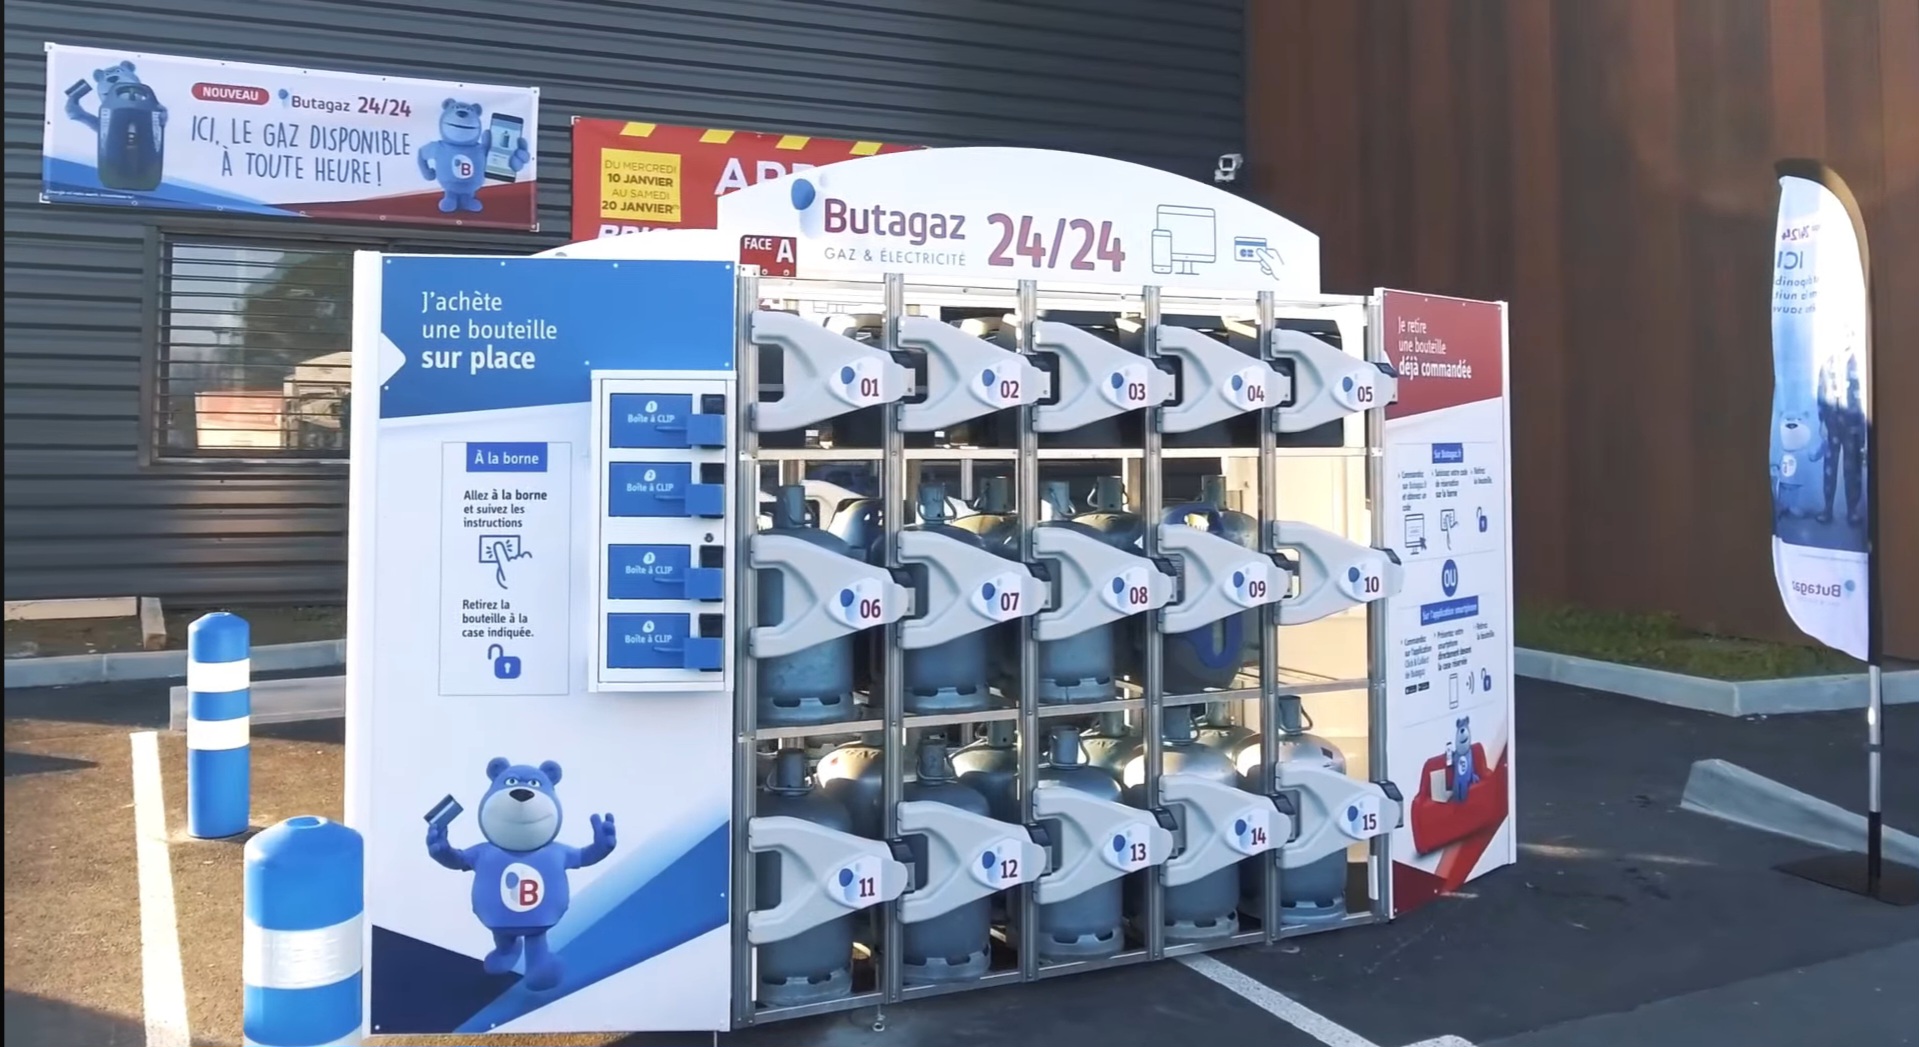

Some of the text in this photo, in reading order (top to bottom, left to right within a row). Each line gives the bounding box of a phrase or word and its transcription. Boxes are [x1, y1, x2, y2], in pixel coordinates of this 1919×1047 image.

[202, 86, 259, 101] NOUVEAU
[291, 95, 412, 117] Butagaz 24/24
[231, 118, 252, 145] LE
[263, 122, 299, 148] GAZ
[310, 125, 411, 156] DISPONIBLE
[221, 144, 233, 177] À
[245, 152, 304, 179] TOUTE
[604, 160, 677, 174] DU MERCREDI
[607, 173, 674, 187] 10 JANVIER
[612, 189, 670, 200] AU SAMEDI
[602, 200, 617, 210] 20
[824, 198, 1126, 272] Butagaz 24/24
[744, 237, 794, 263] FACE A
[824, 247, 966, 266] GAZ & ÉLECTRICITÉ
[421, 290, 502, 313] J’achète
[422, 318, 558, 340] une bouteille
[1398, 317, 1427, 334] Je retire
[1399, 338, 1446, 355] une bouteille
[421, 344, 536, 375] sur place
[1399, 356, 1472, 380] déjà commandée
[861, 377, 879, 397] 01
[1000, 380, 1019, 398] 02
[1128, 383, 1146, 401] 03
[1247, 385, 1265, 402] 04
[1357, 386, 1373, 402] 05
[627, 414, 675, 423] Boîte à CLIP
[474, 449, 539, 464] À la borne
[464, 489, 547, 500] Allez à la borne
[626, 483, 674, 492] Boîte à CLIP
[464, 503, 525, 514] et suivez les
[463, 517, 523, 528] instructions
[625, 565, 673, 574] Boîte à CLIP
[1444, 569, 1456, 587] OU
[1249, 581, 1266, 598] 09
[1364, 576, 1379, 593] 10
[1000, 592, 1020, 611] 07
[1129, 586, 1148, 604] 08
[462, 599, 510, 610] Retirez la
[860, 599, 881, 618] 06
[462, 612, 528, 623] bouteille à la
[462, 626, 534, 639] case indiquée.
[624, 634, 672, 643] Boîte à CLIP
[1362, 813, 1377, 831] 15
[1250, 827, 1267, 846] 14
[1130, 843, 1147, 862] 13
[1000, 859, 1018, 878] 12
[519, 879, 539, 906] B
[859, 878, 875, 897] 11
